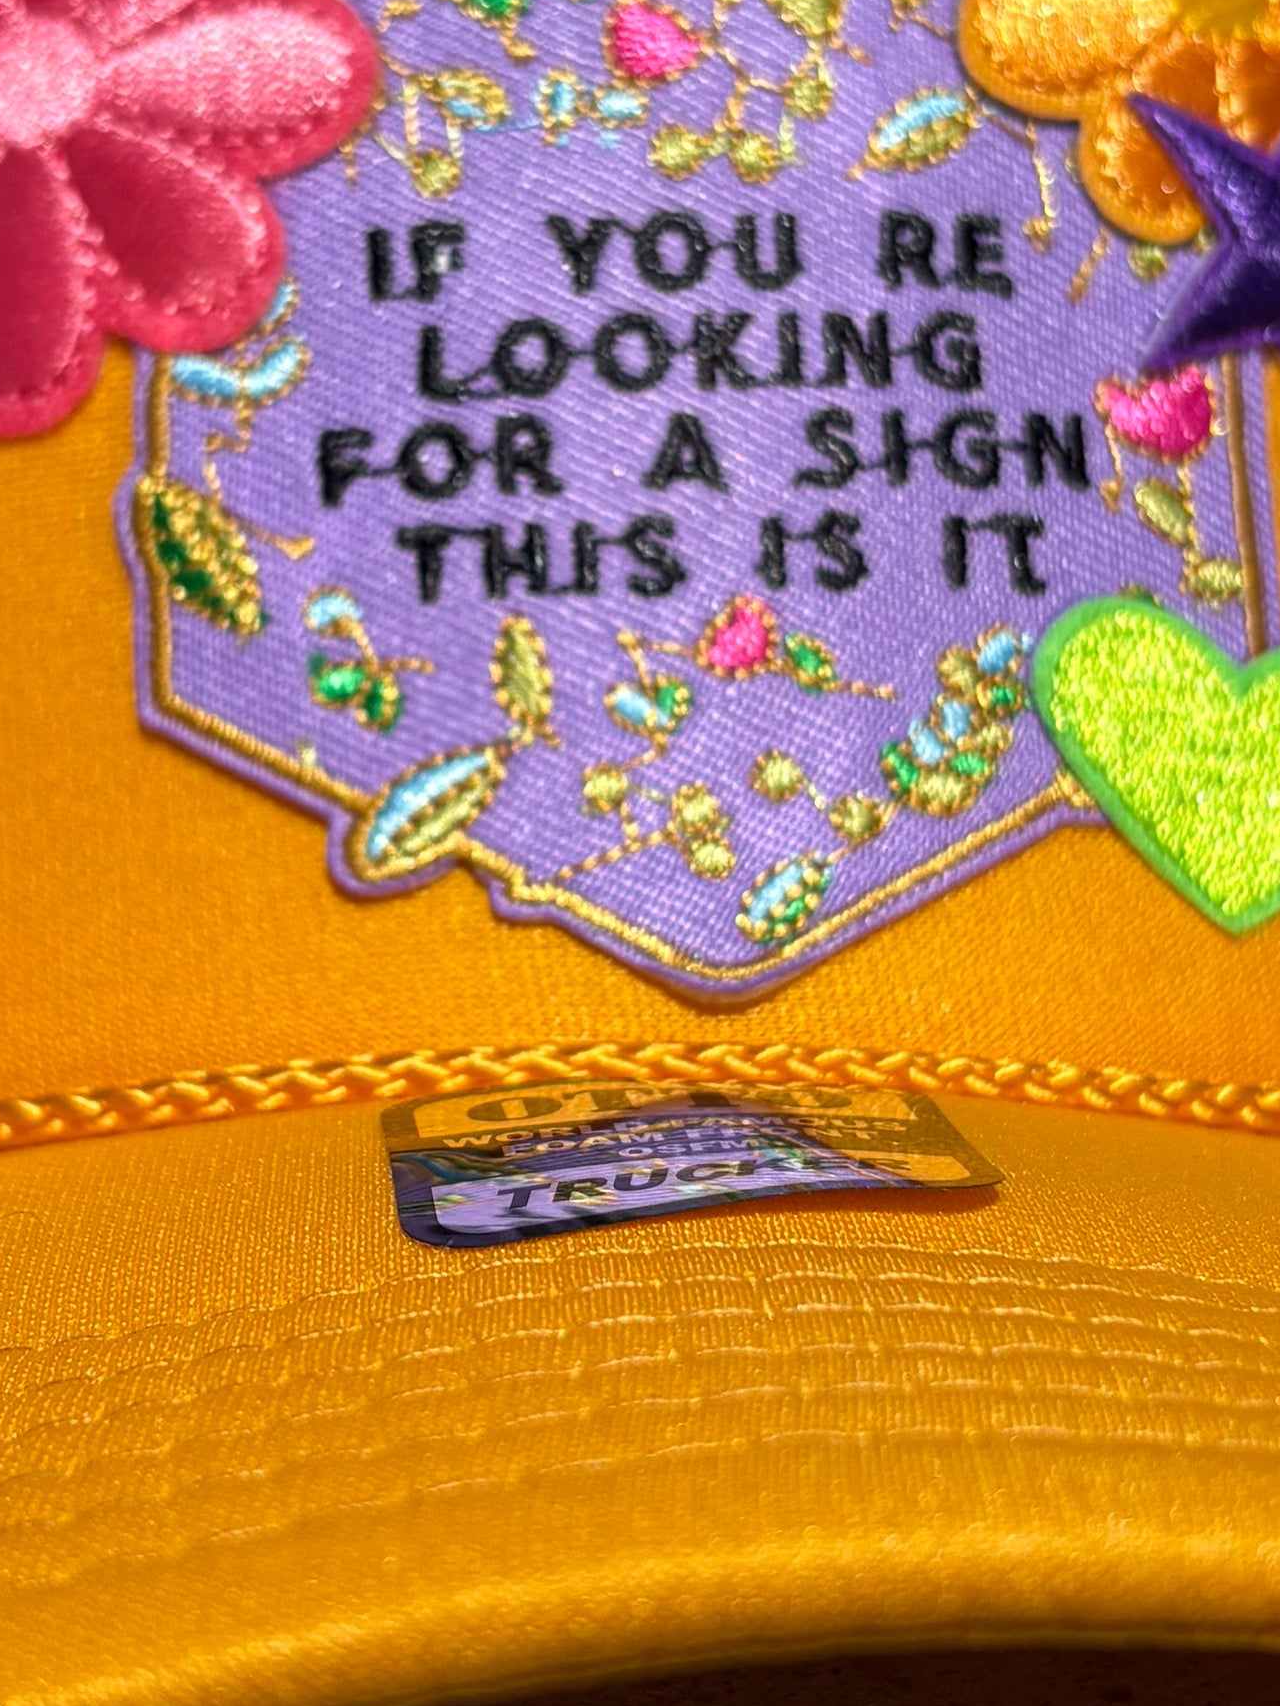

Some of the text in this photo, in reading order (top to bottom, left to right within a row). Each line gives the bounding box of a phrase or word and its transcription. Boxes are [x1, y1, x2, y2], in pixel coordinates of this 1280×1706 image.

[366, 209, 1014, 303] IF YOU RE
[416, 309, 983, 403] LOOKING
[318, 407, 1090, 506] FOR A SIGN
[396, 510, 1046, 604] THIS IS IT
